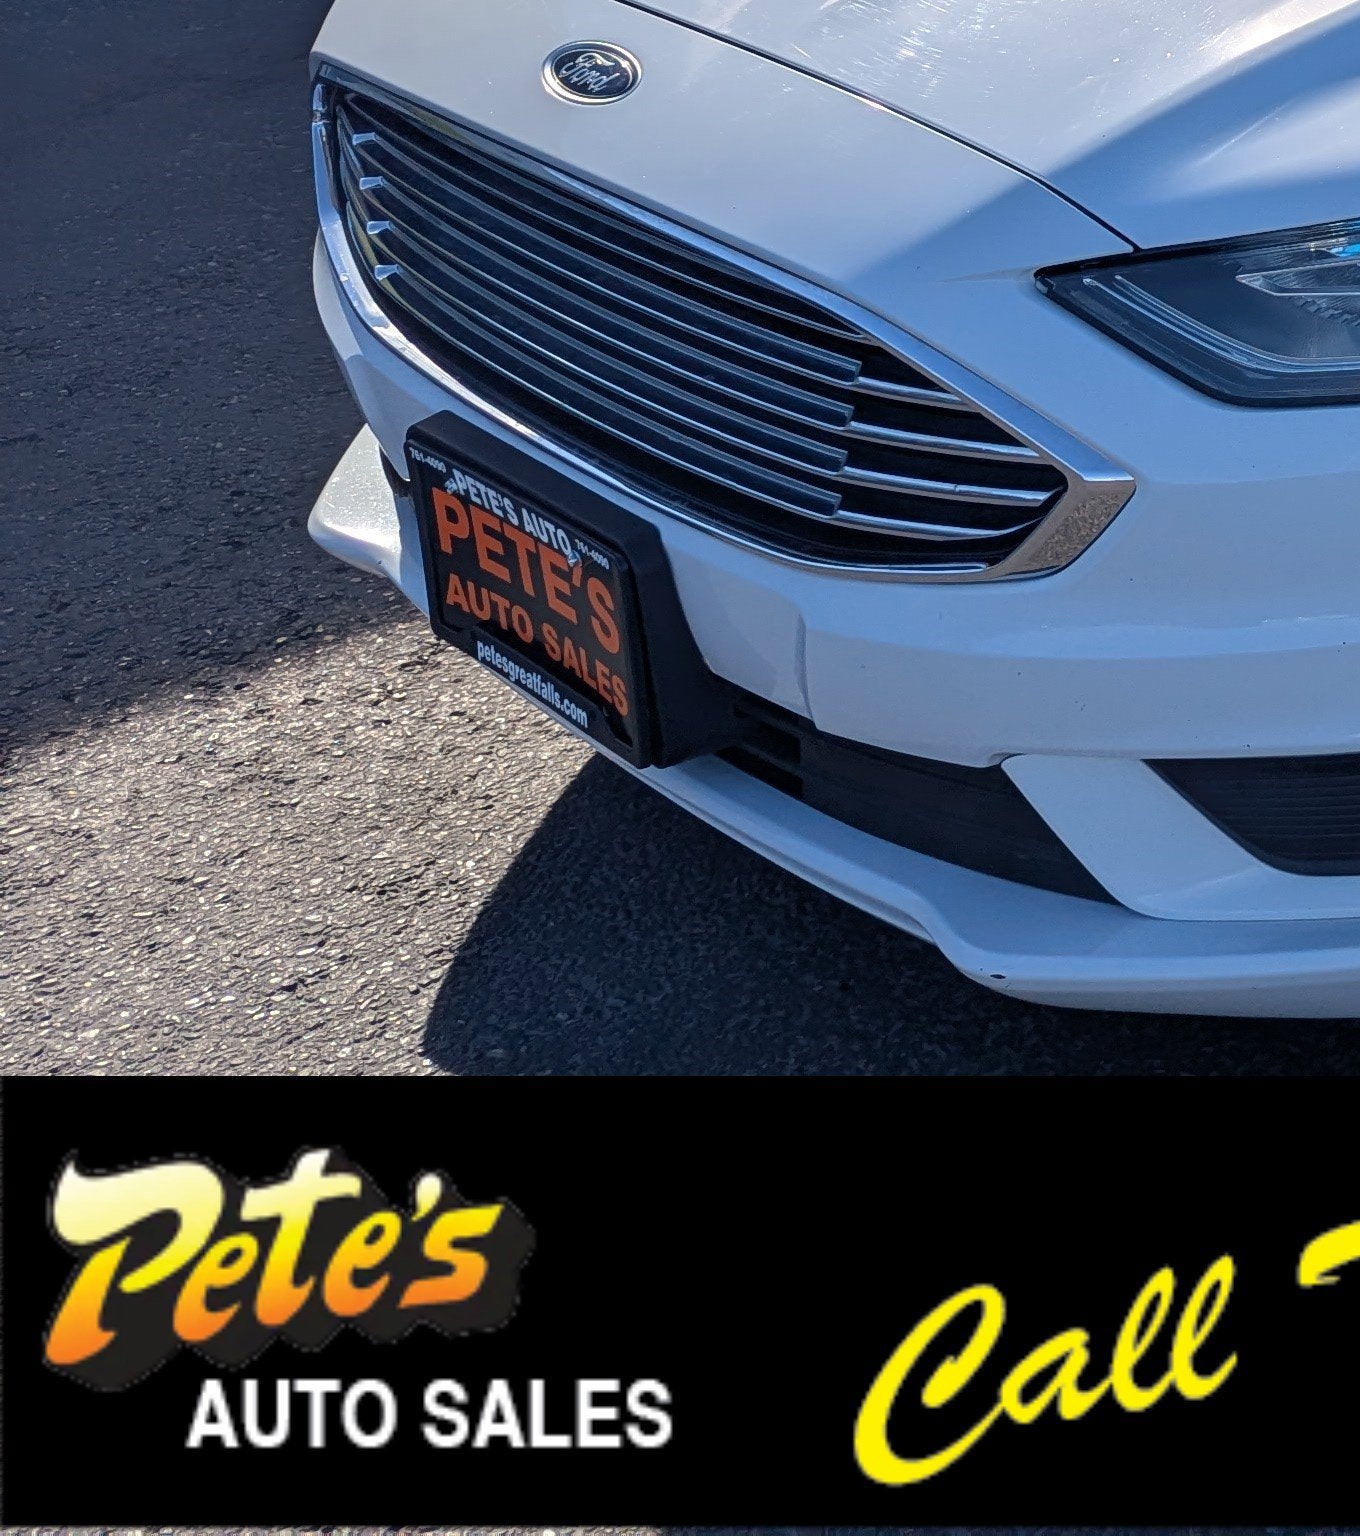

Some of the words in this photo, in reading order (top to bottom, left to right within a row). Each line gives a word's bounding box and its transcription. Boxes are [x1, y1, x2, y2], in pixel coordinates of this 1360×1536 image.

[558, 52, 620, 93] Ford
[453, 468, 519, 526] PETE'S
[521, 507, 572, 556] AUTO
[431, 486, 620, 655] PETE'S
[446, 572, 534, 644] AUTO
[541, 622, 629, 716] SALES
[476, 640, 588, 728] petesgreatfalls.com
